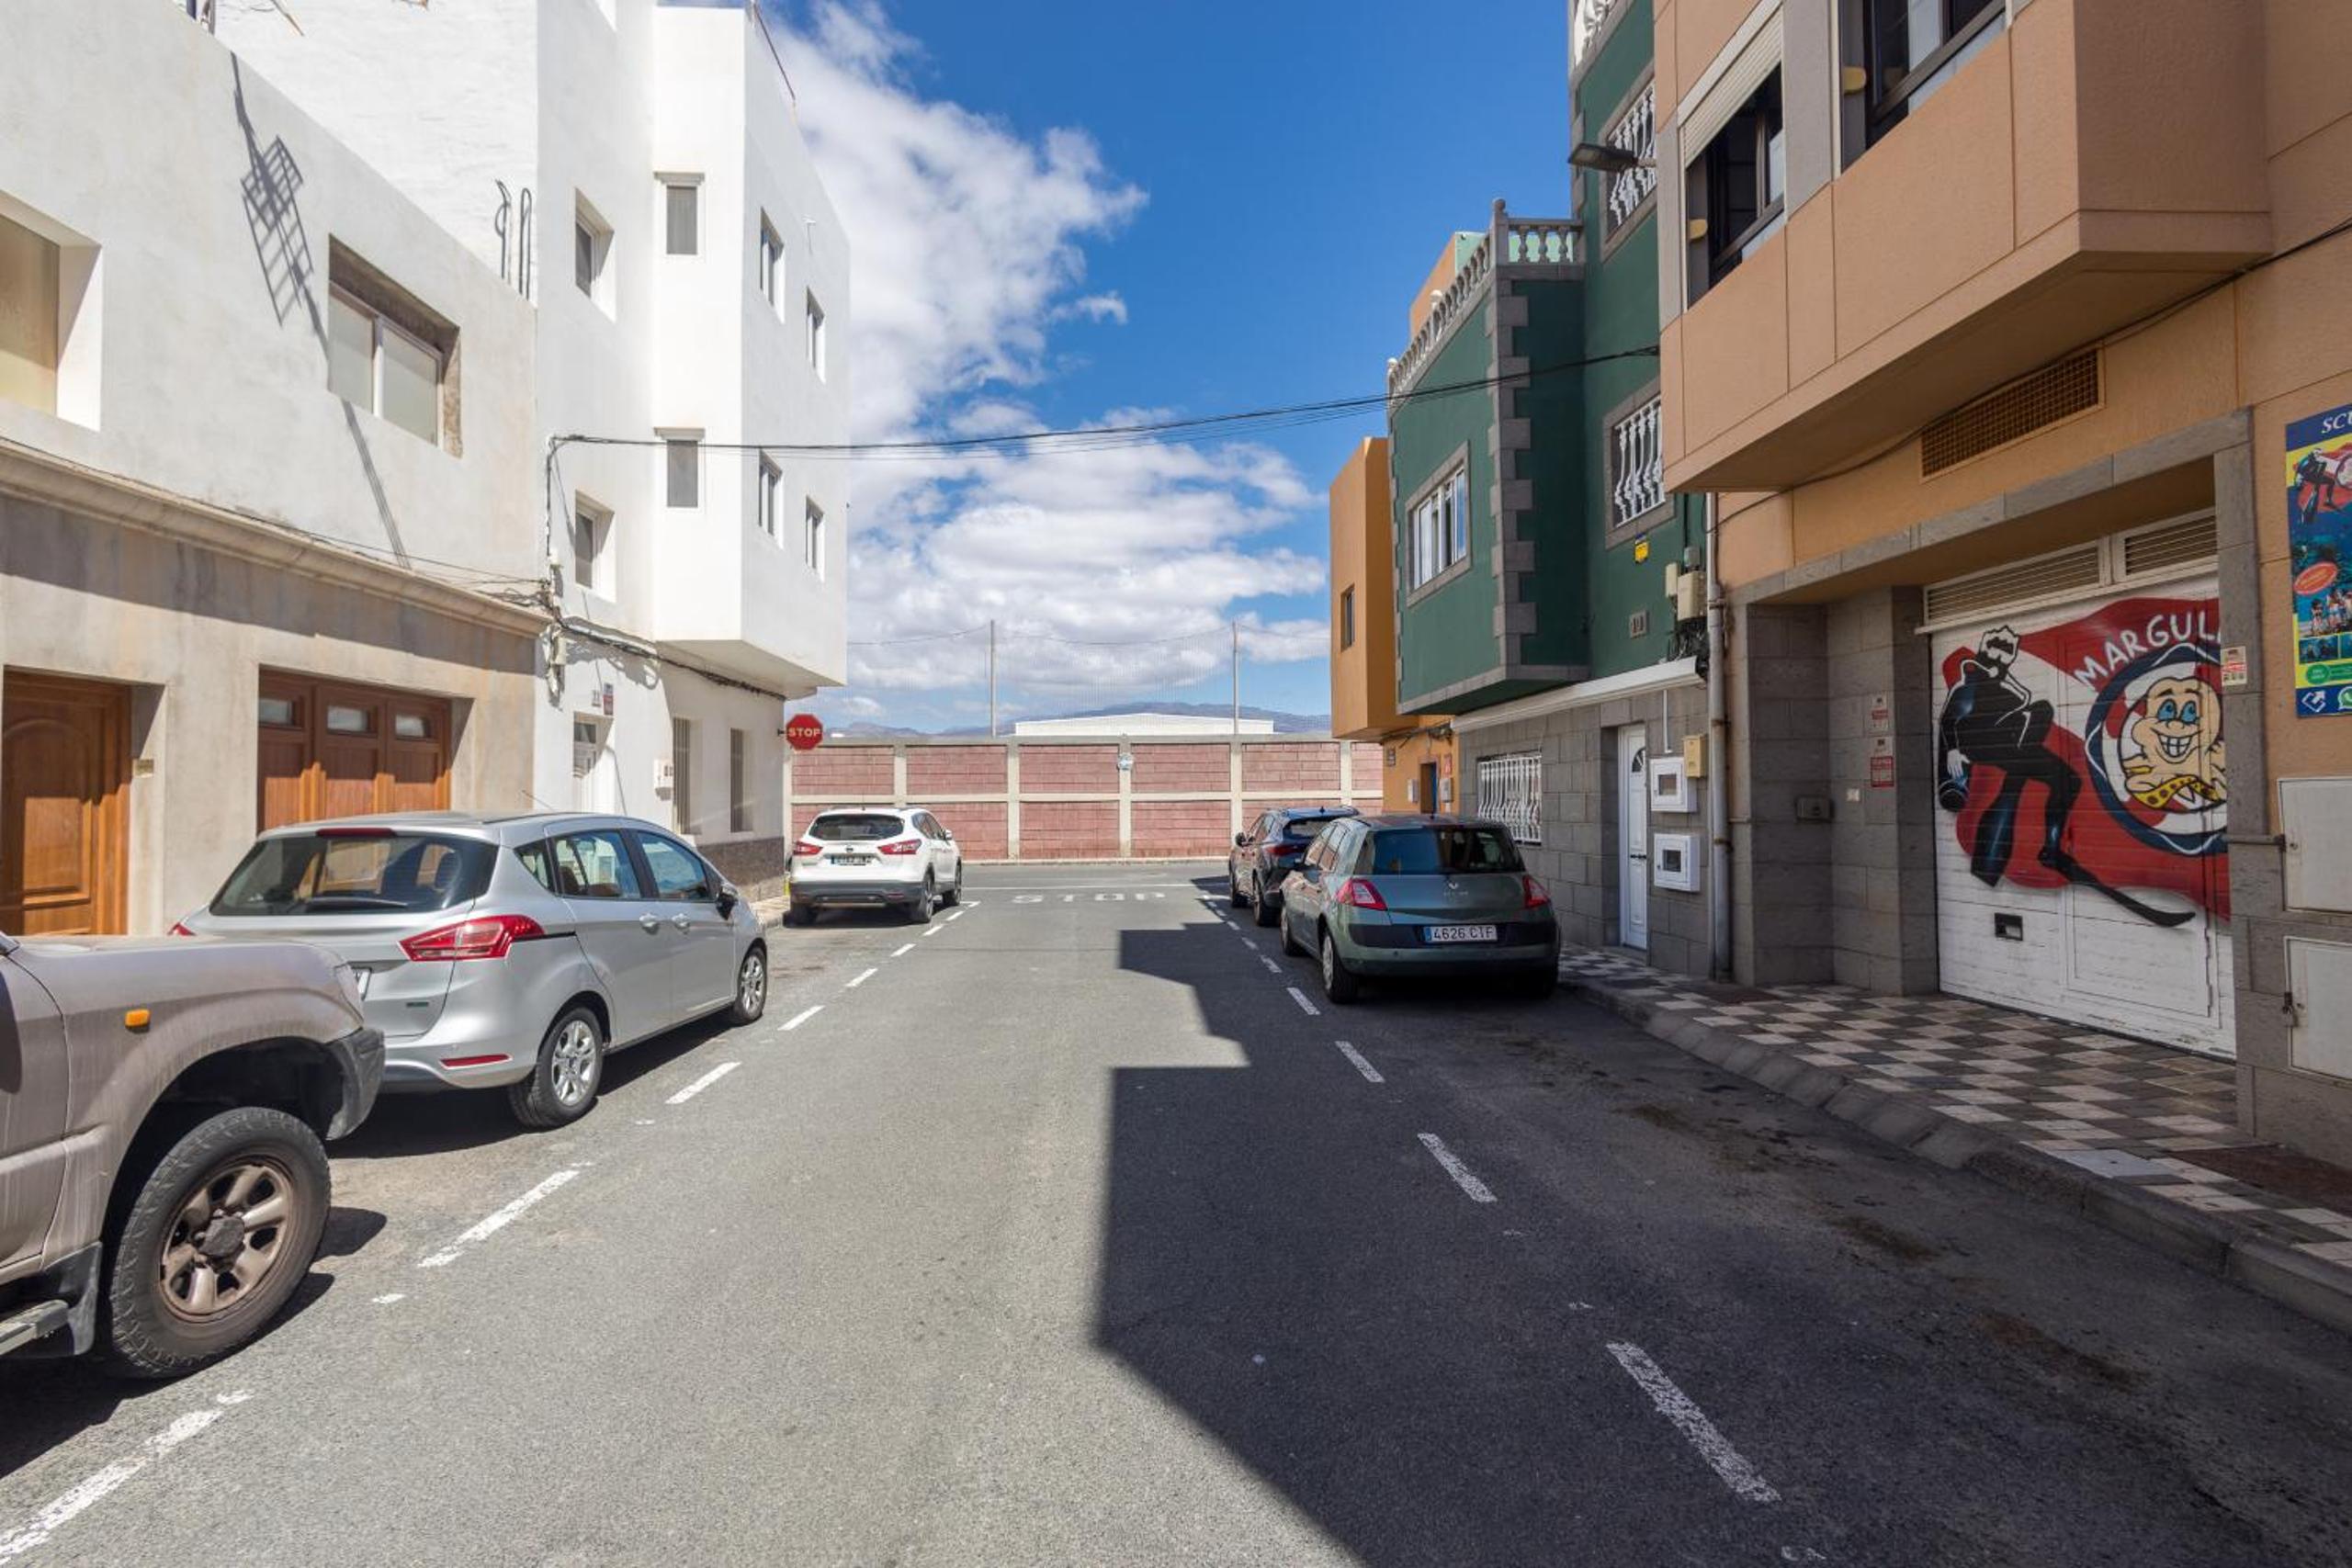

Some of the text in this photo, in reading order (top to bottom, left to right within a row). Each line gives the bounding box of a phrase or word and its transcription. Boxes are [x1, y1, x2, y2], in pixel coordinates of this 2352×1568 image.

[2074, 611, 2221, 694] MARGUL
[788, 727, 820, 738] STOP
[1433, 927, 1465, 940] 4626
